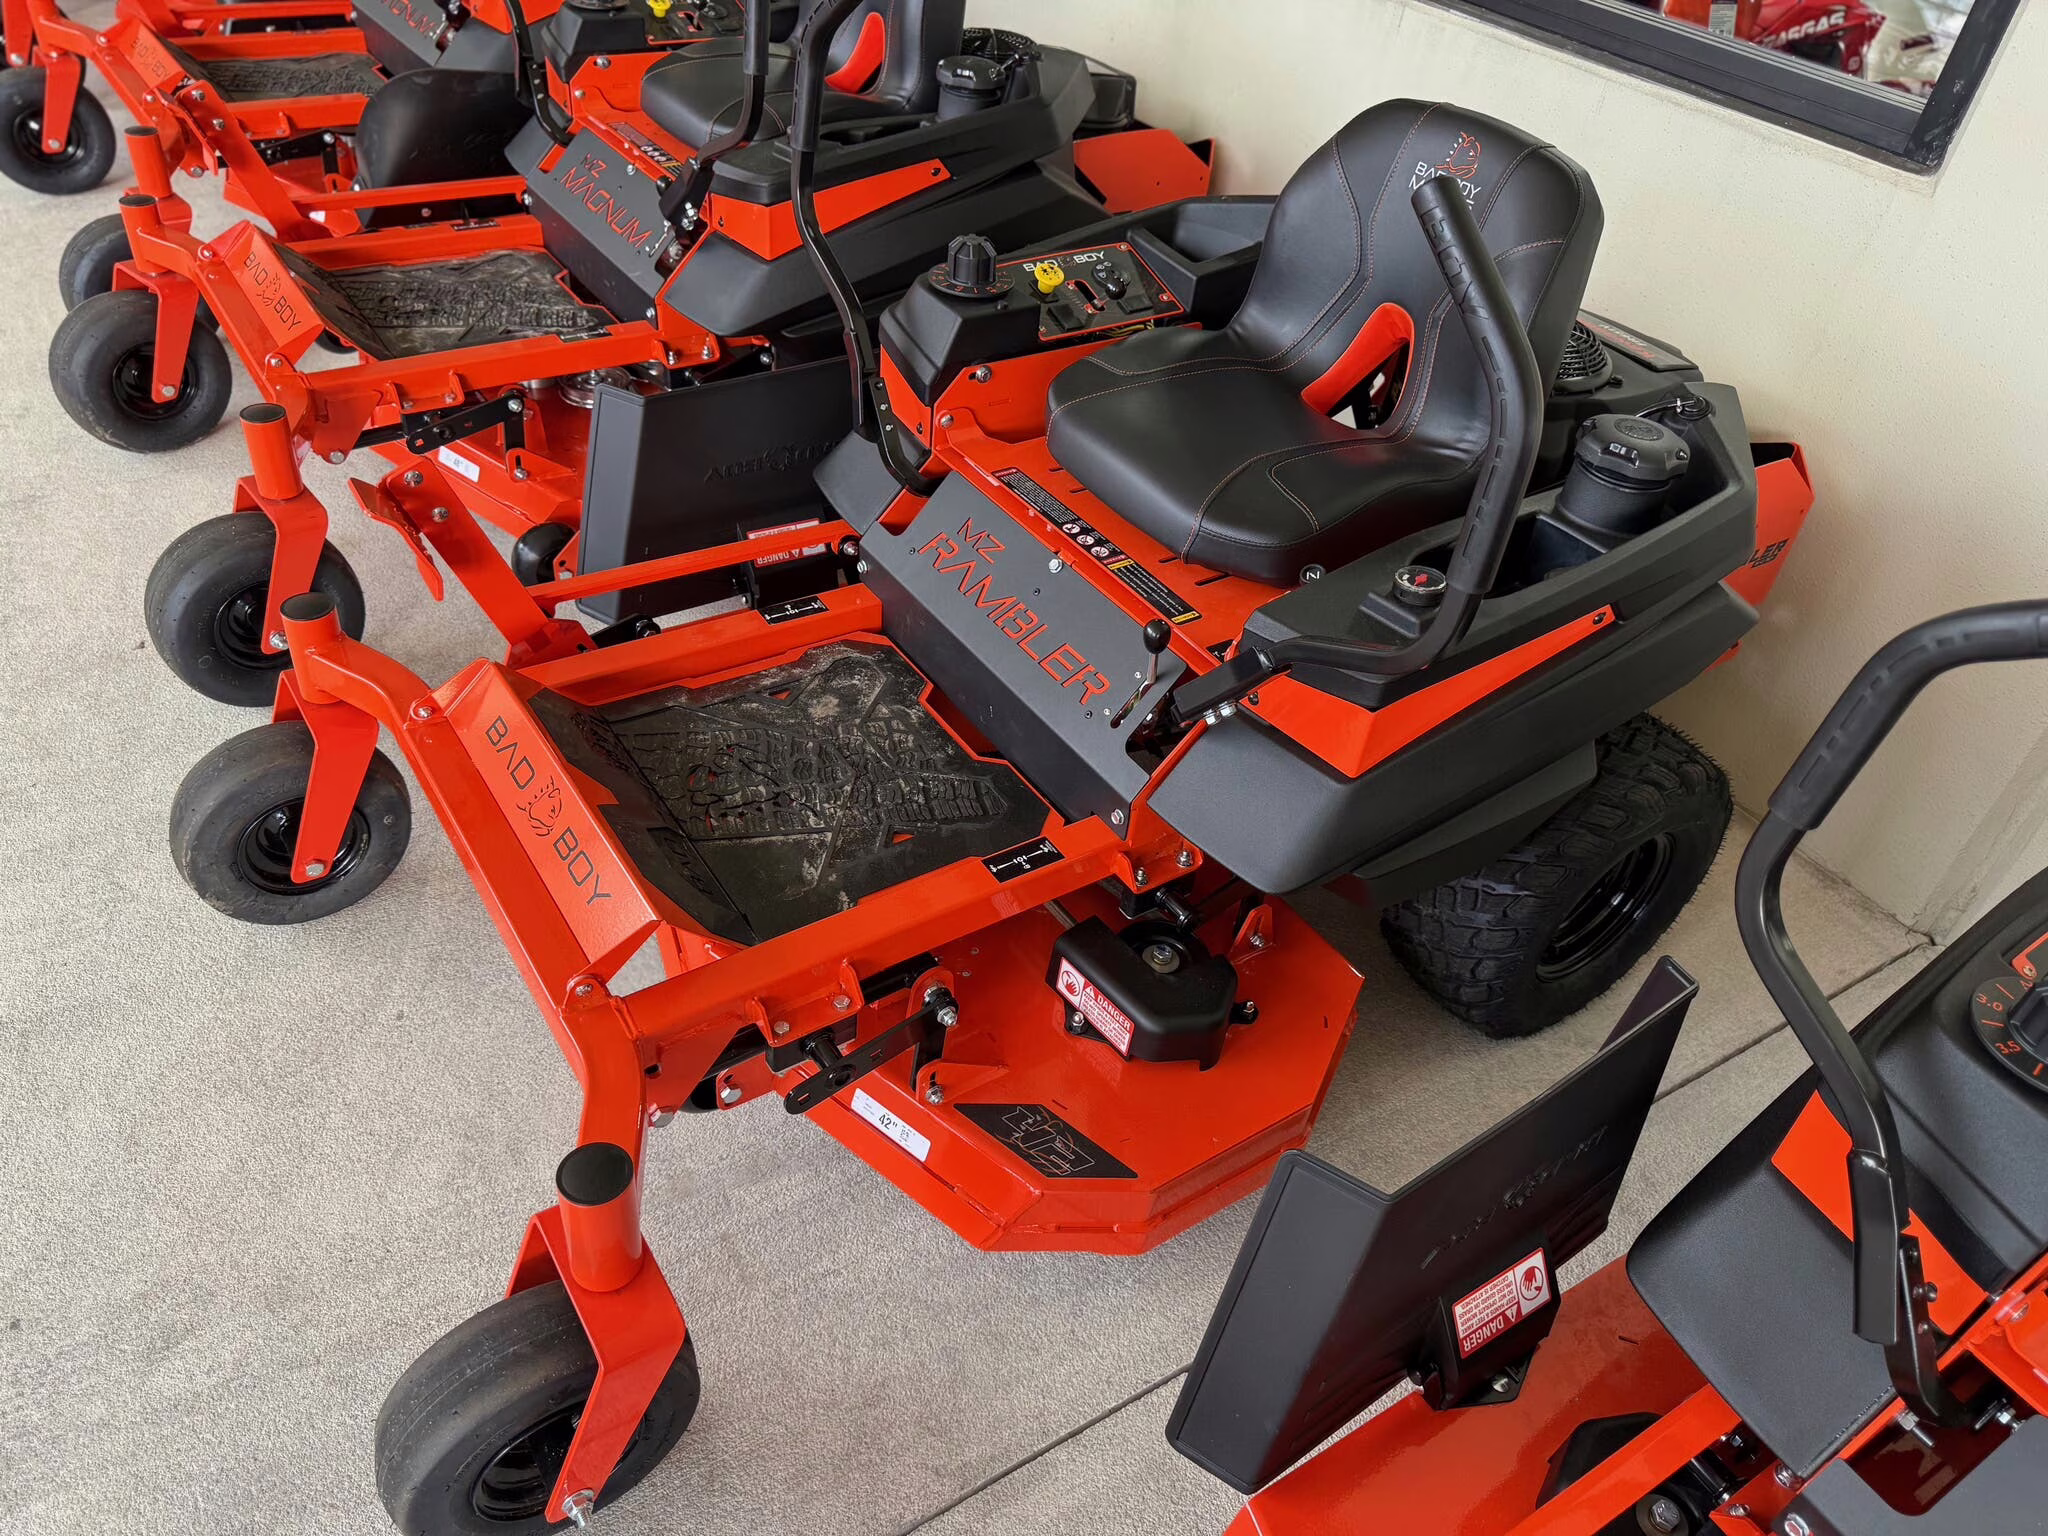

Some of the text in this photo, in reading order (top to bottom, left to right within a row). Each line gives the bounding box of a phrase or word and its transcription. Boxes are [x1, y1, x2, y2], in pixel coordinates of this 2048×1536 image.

[383, 0, 435, 34] GNUM
[560, 166, 653, 249] MAGNUM
[1073, 250, 1105, 264] BOY
[243, 251, 302, 331] BAD BOY
[957, 517, 1006, 565] MZ
[918, 531, 1111, 705] RAMBLER
[485, 715, 536, 790] BAD
[553, 826, 612, 906] BOY
[1097, 996, 1131, 1030] DANGER
[1976, 993, 2004, 1012] 3.0
[1995, 1040, 2022, 1055] 3.5
[878, 1113, 898, 1130] 42"
[1463, 1315, 1505, 1352] DANGER
